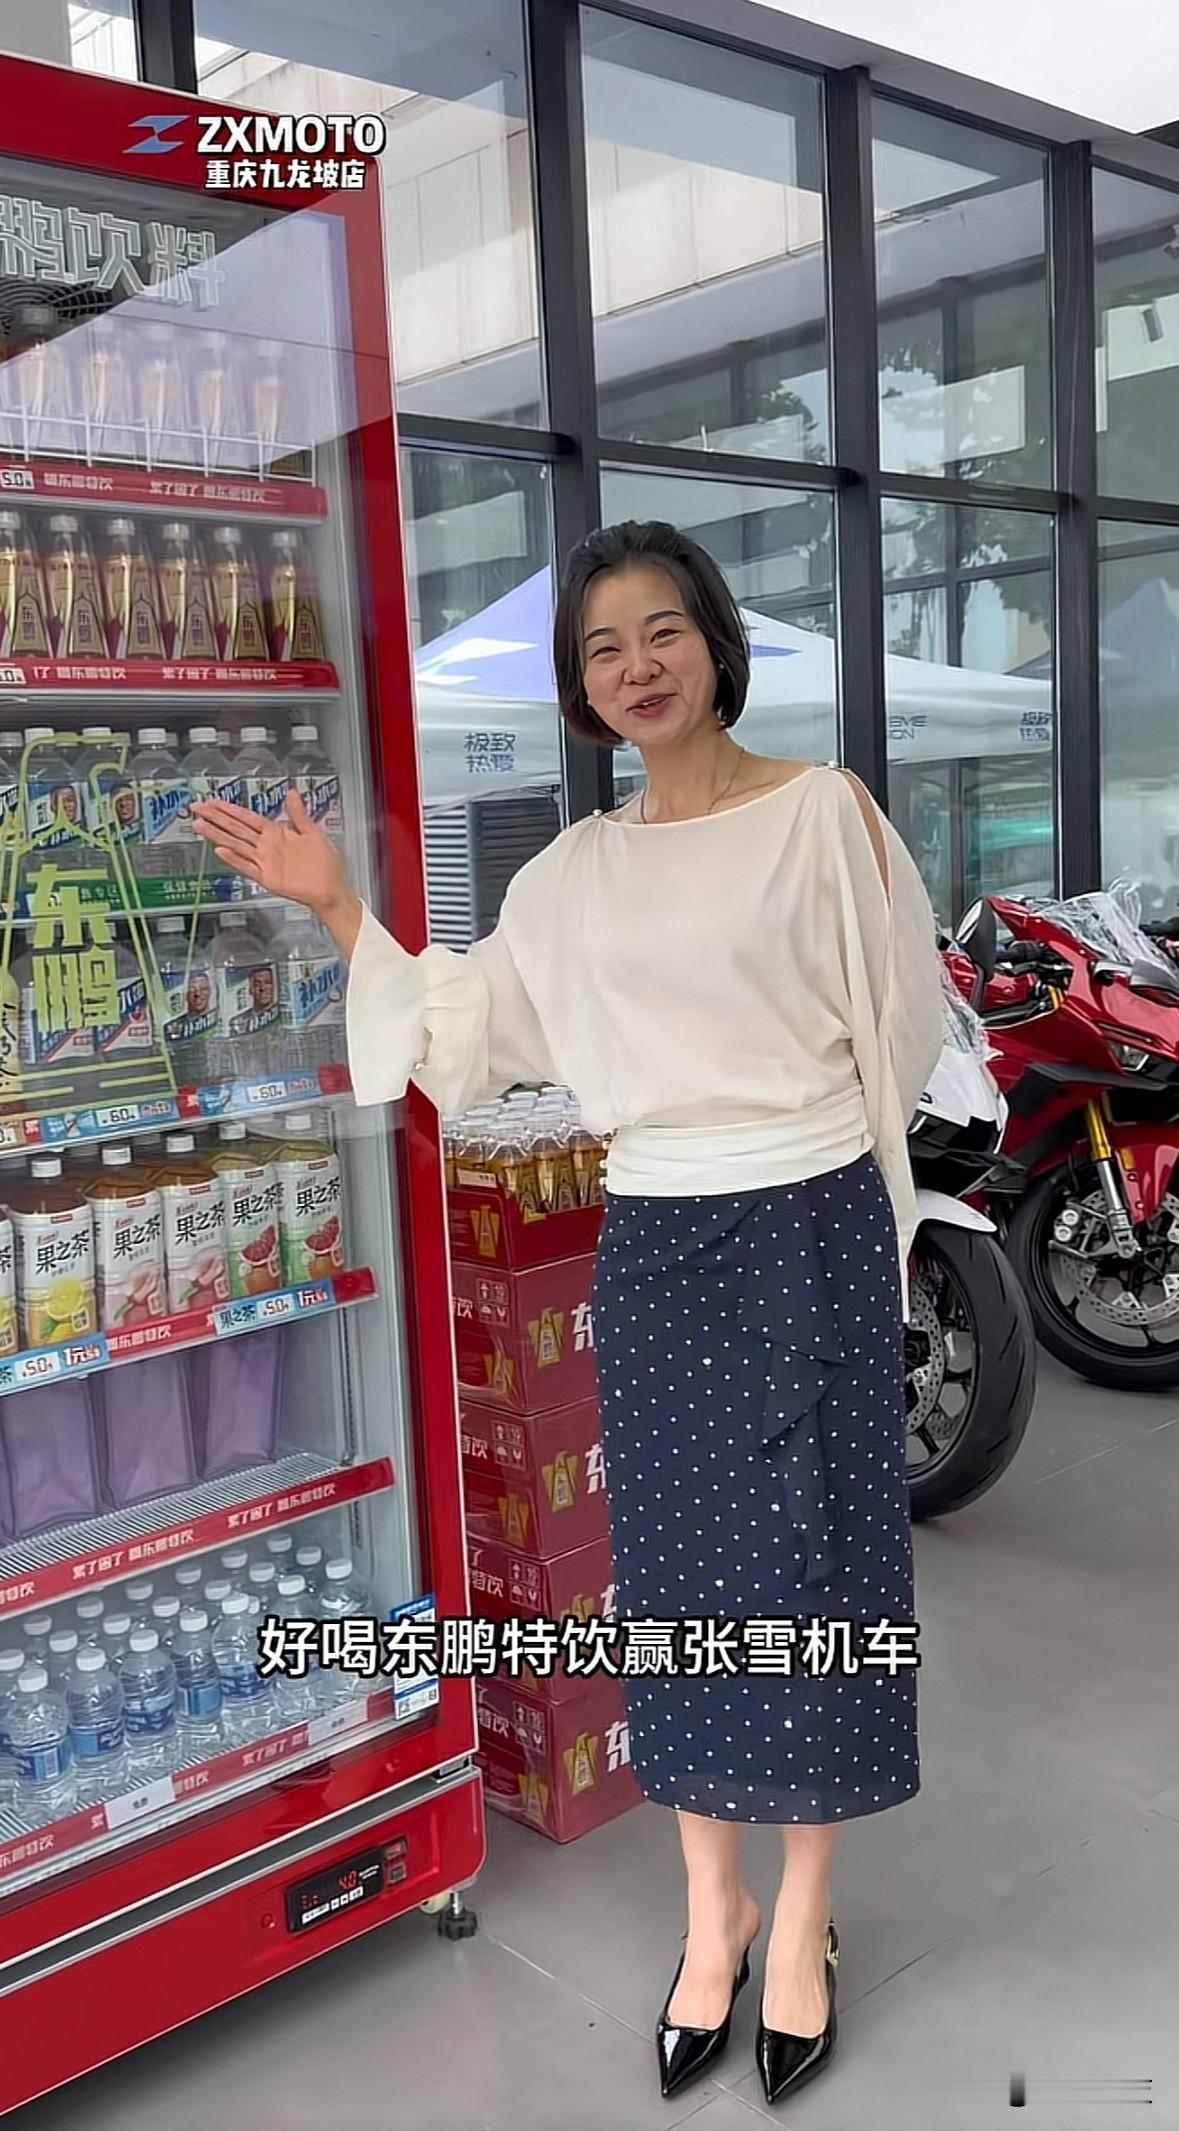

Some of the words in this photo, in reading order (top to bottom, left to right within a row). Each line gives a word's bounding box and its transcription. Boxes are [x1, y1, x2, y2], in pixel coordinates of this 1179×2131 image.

[464, 733, 516, 752] 极致
[26, 863, 121, 1034] 东鹏
[232, 1182, 278, 1227] 果之茶
[296, 1176, 341, 1217] 果之茶
[113, 1213, 161, 1259] 果之茶
[175, 1200, 226, 1246] 果之茶
[36, 1228, 90, 1275] 果之茶
